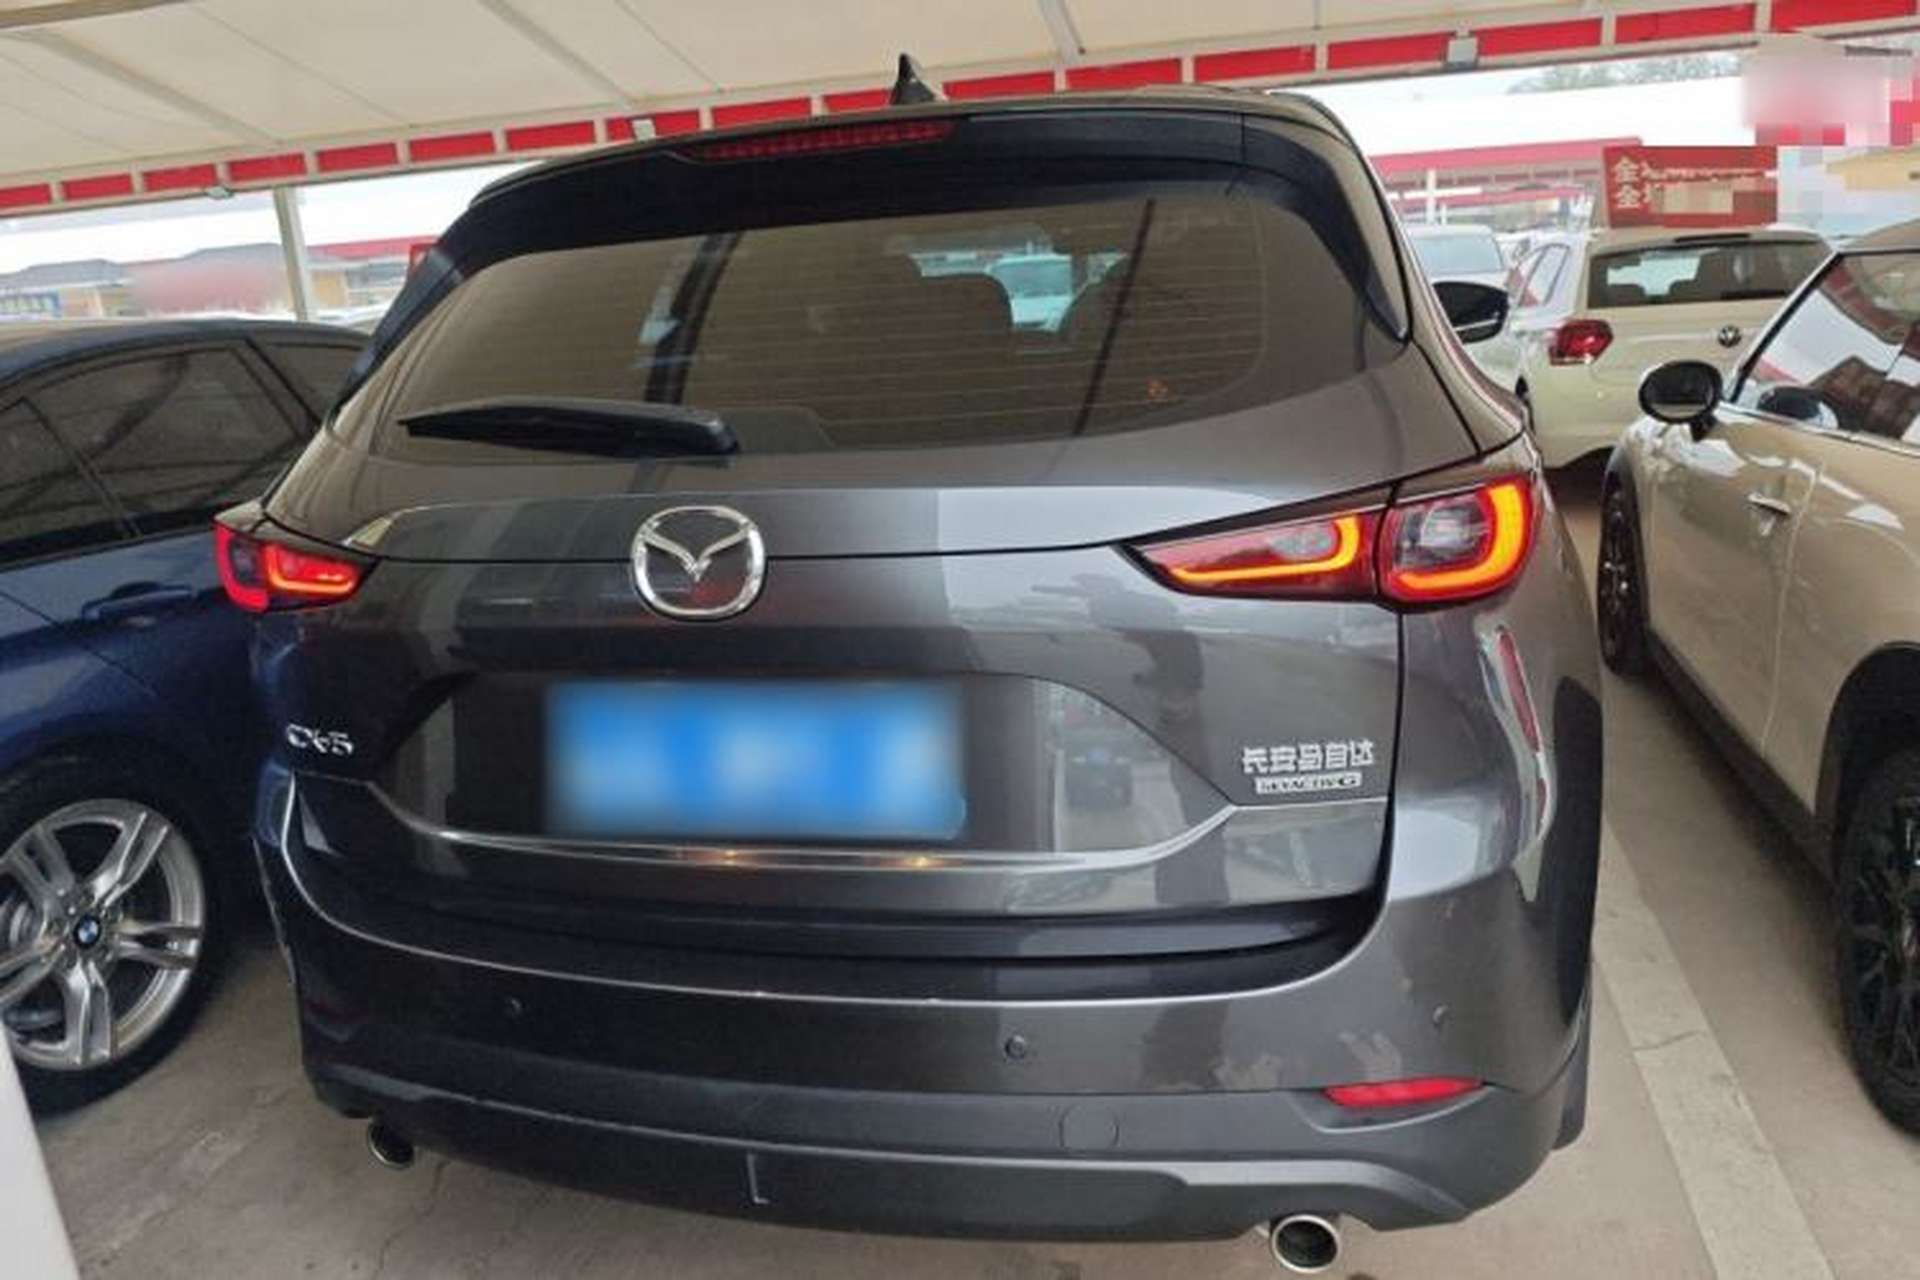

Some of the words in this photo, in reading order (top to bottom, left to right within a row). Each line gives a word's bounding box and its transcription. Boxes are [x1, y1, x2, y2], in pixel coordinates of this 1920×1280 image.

[1242, 739, 1374, 774] 长安马自达
